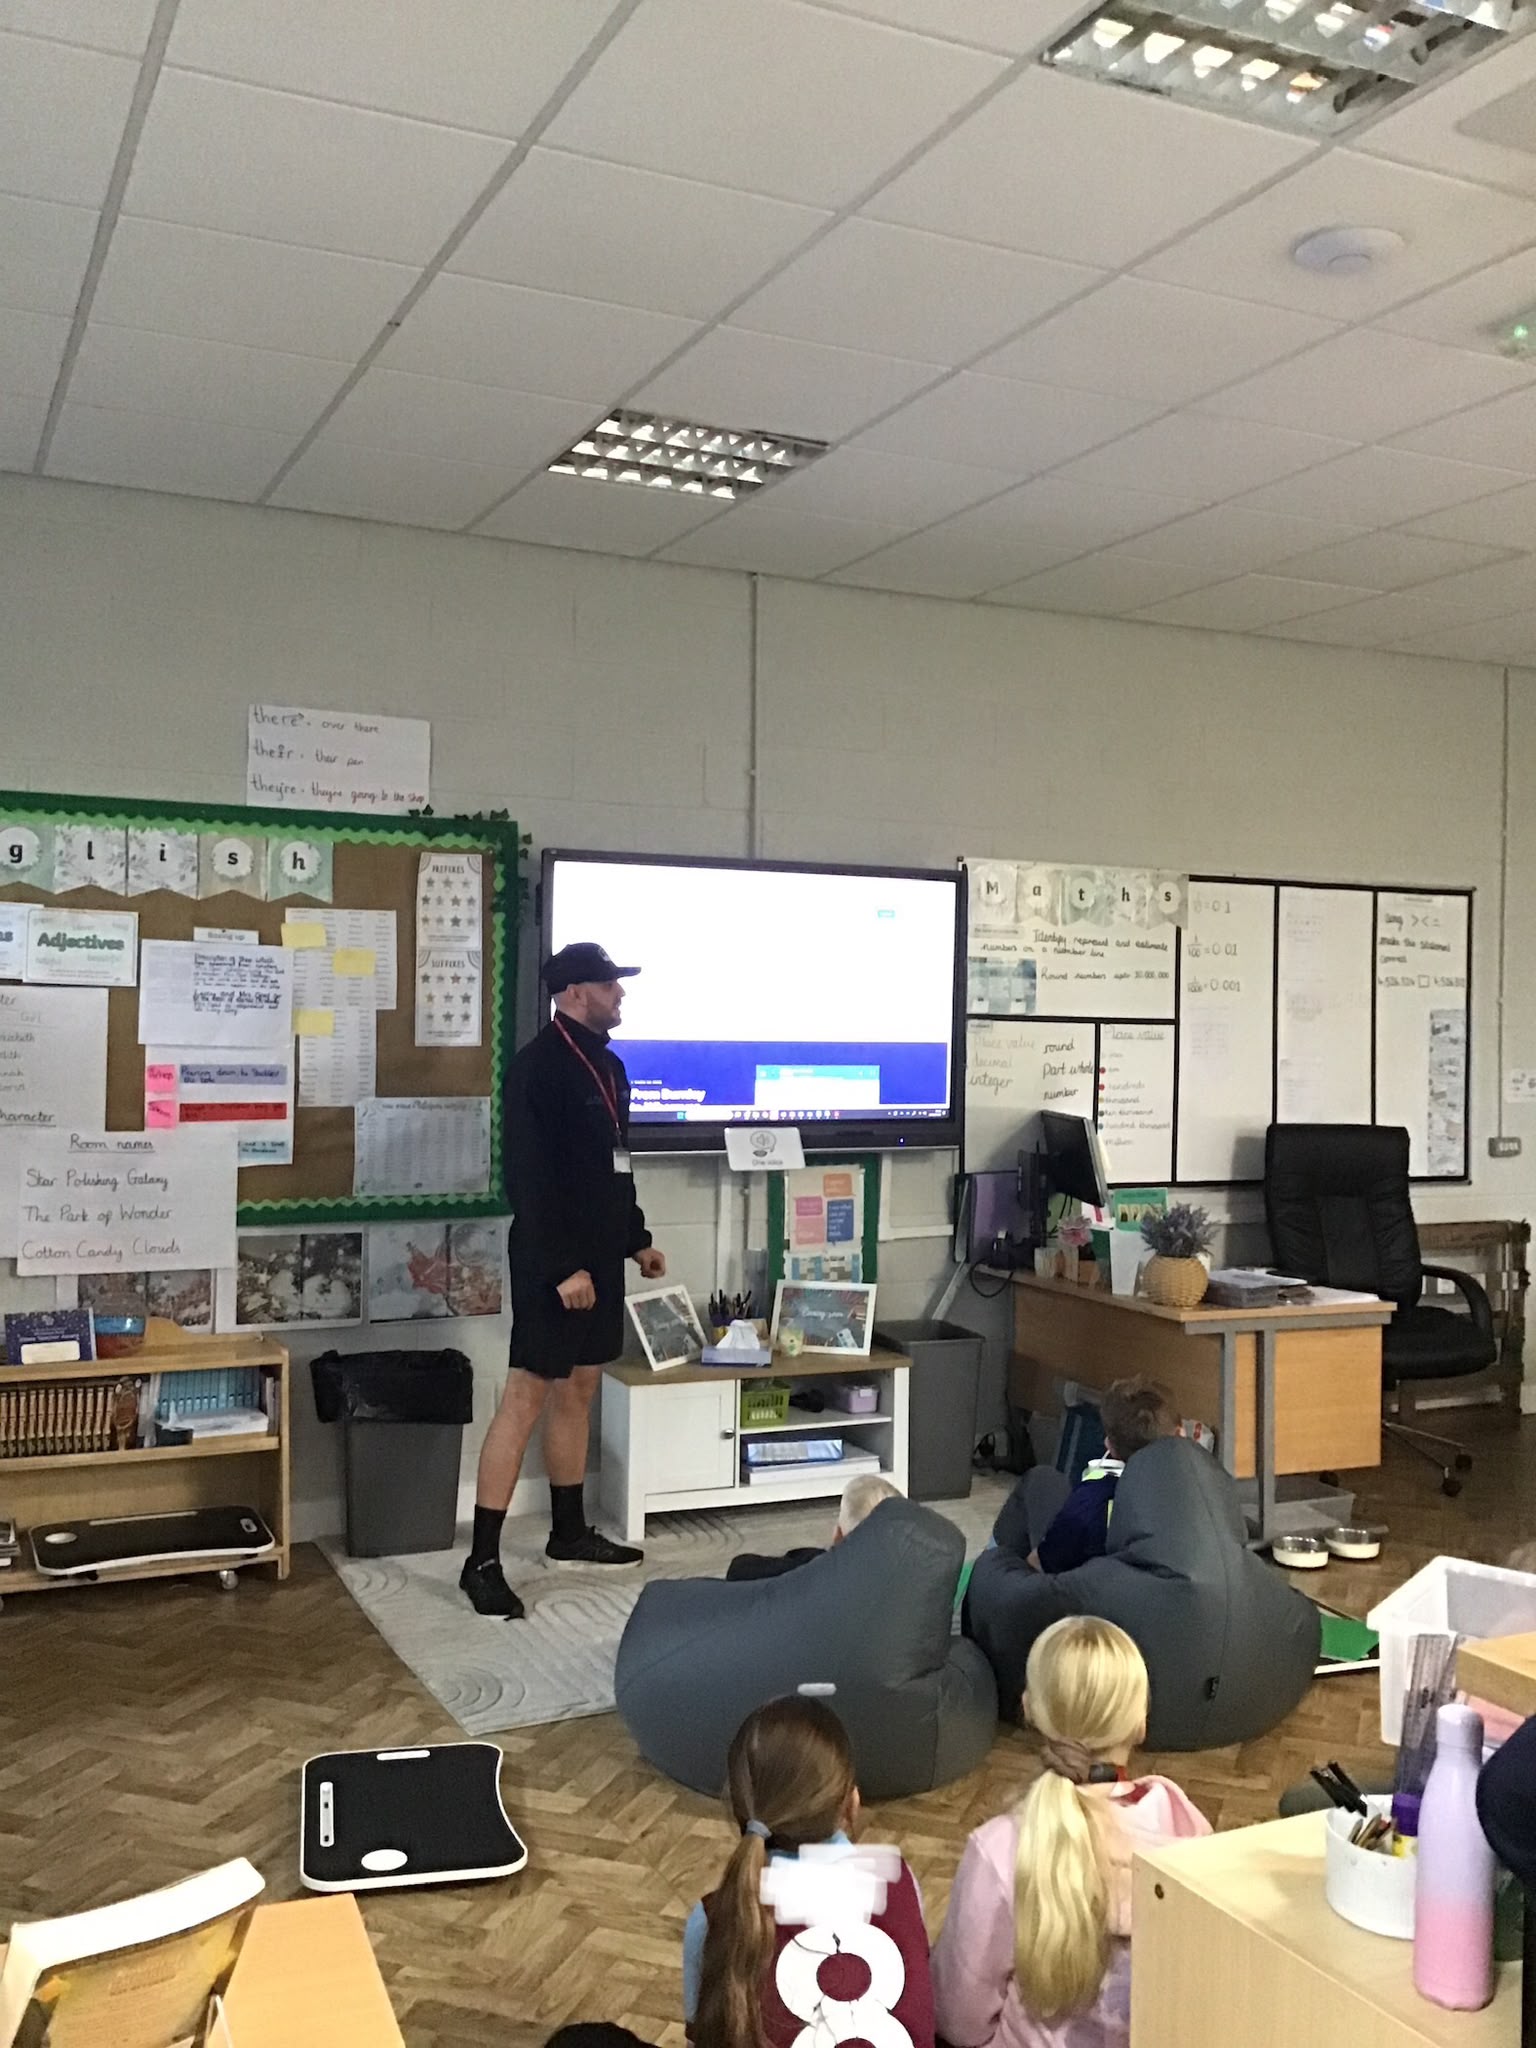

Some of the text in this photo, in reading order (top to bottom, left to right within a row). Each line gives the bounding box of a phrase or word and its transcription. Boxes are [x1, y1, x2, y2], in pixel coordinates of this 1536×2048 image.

[37, 931, 125, 952] Adjectives
[1043, 1086, 1079, 1101] number
[70, 1133, 154, 1150] Room names
[26, 1167, 168, 1192] Star Polishing Galaxy
[21, 1203, 173, 1227] The Park of Wonder
[21, 1237, 181, 1262] Cotton Candy Clouds
